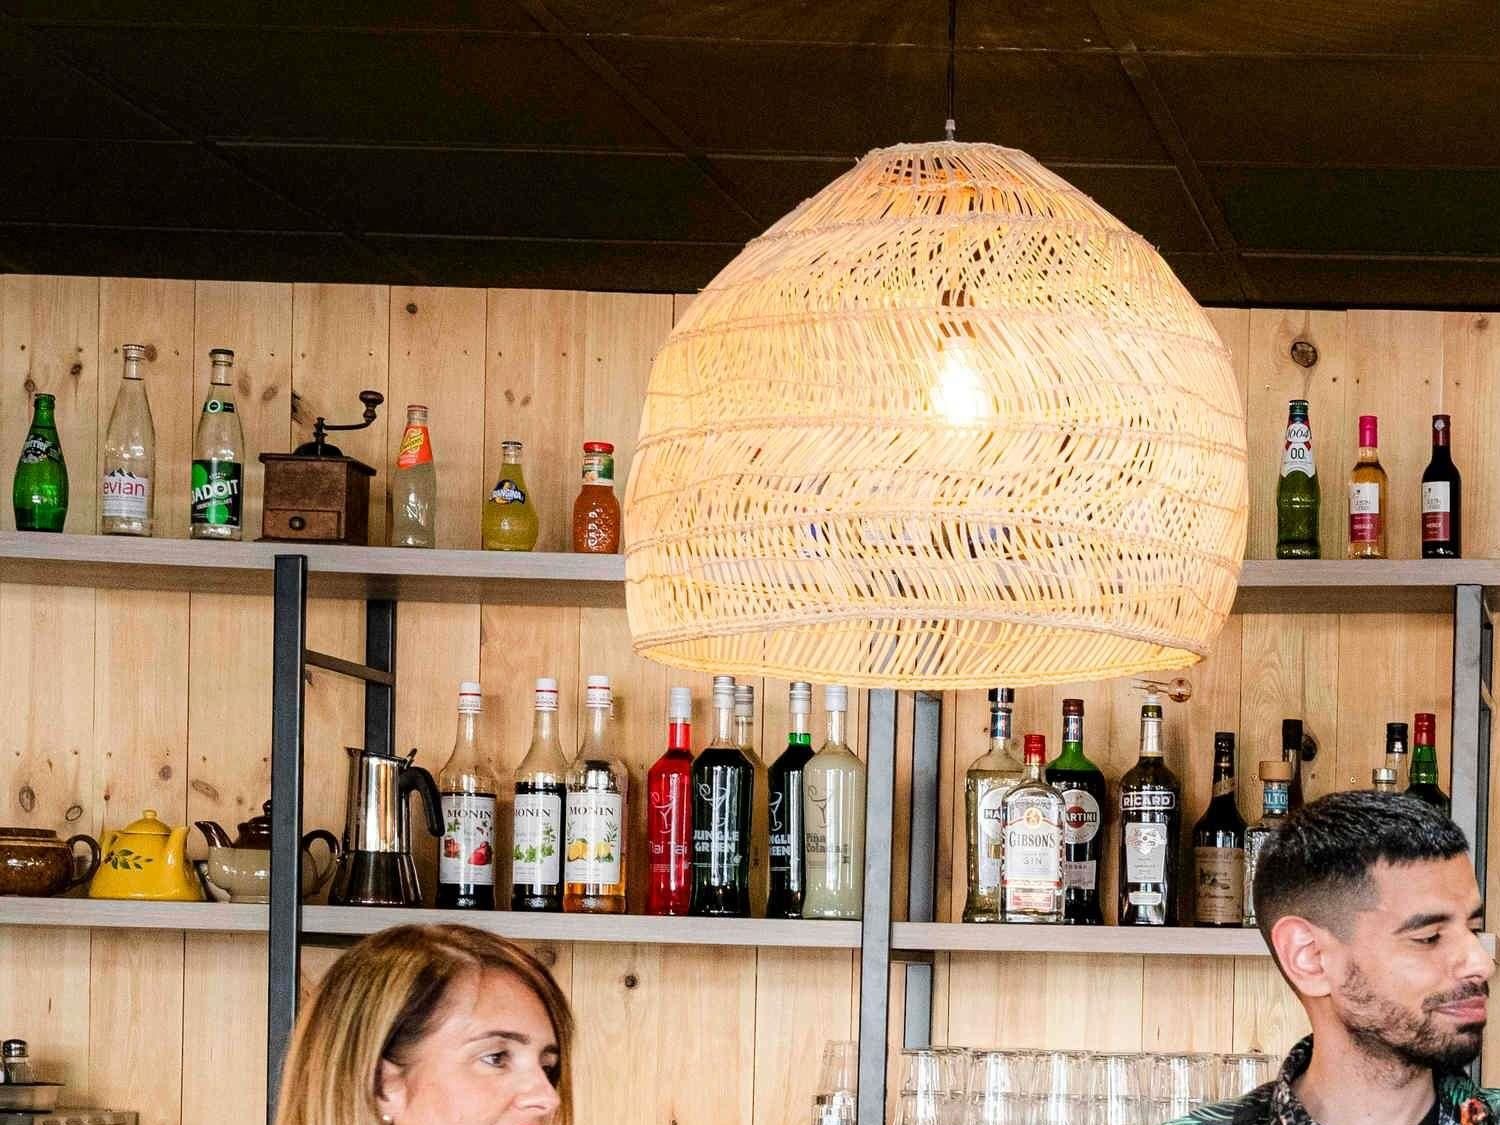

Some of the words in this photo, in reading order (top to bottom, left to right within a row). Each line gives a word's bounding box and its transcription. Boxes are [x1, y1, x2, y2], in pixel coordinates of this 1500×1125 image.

[103, 482, 145, 497] evian
[1123, 796, 1171, 808] RICARD
[448, 808, 492, 821] MONIN
[569, 805, 616, 818] MONIN
[693, 830, 740, 843] JUNGLE
[695, 841, 736, 854] GREEN
